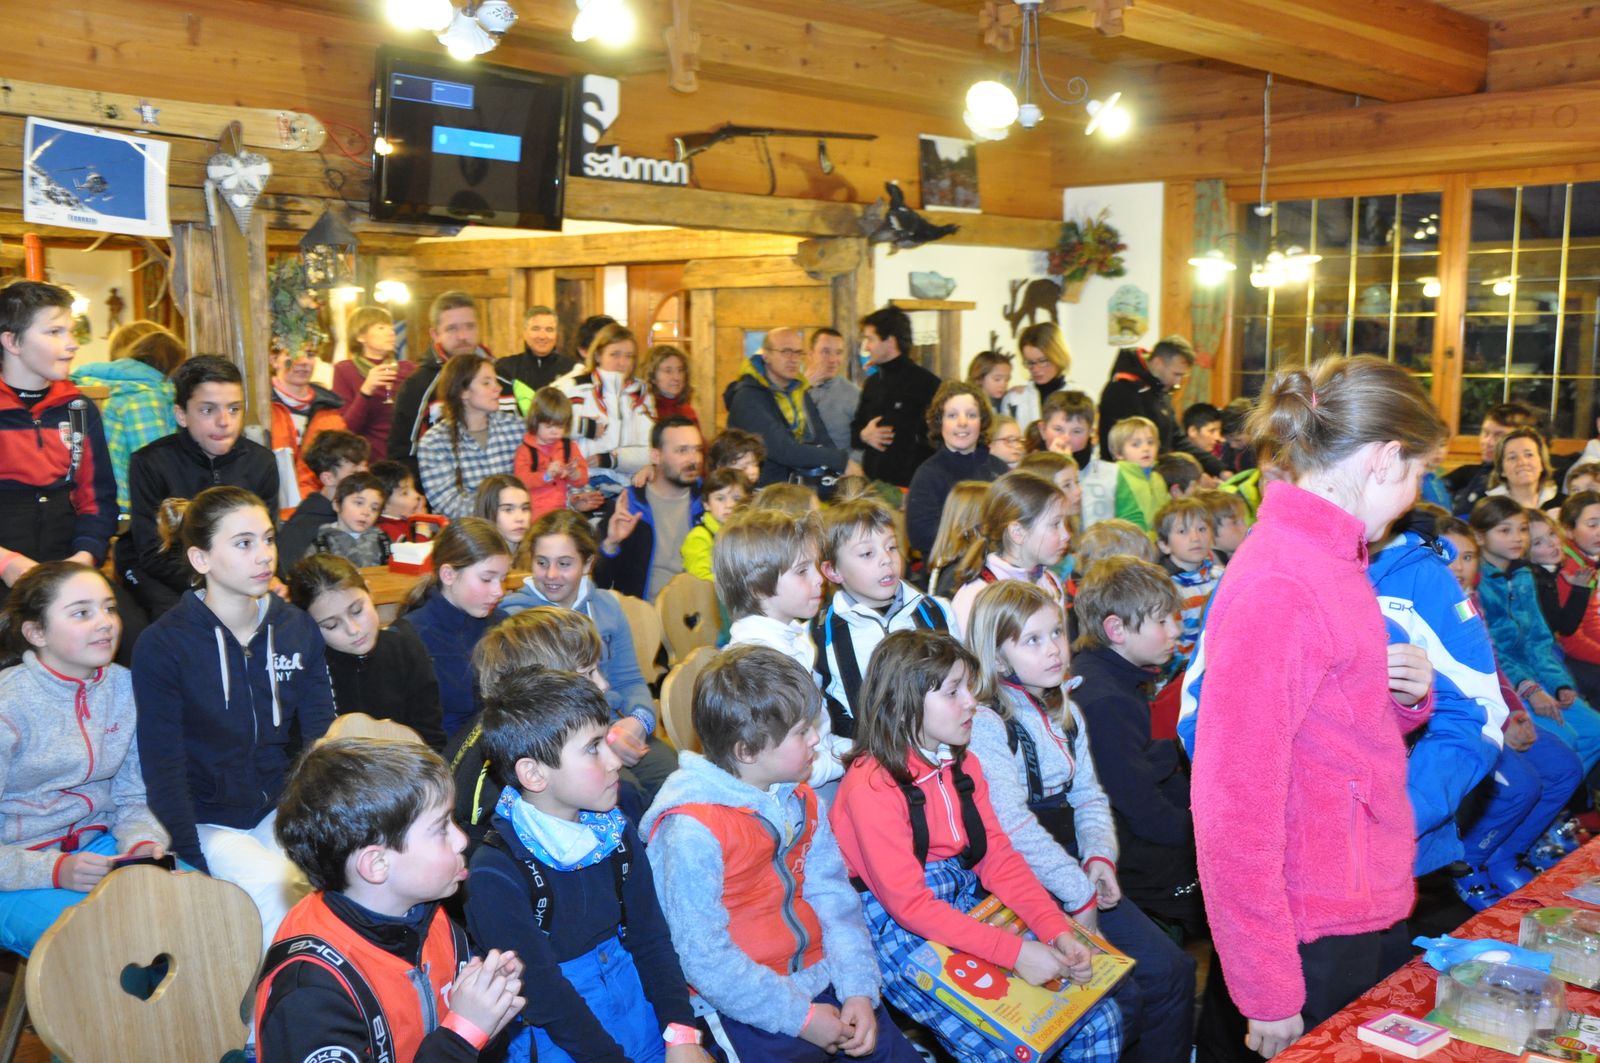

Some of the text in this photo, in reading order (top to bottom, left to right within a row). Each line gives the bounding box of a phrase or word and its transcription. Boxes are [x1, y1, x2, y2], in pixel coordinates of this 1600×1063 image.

[582, 146, 689, 184] salomon
[525, 859, 544, 887] DK
[287, 940, 345, 967] DKB
